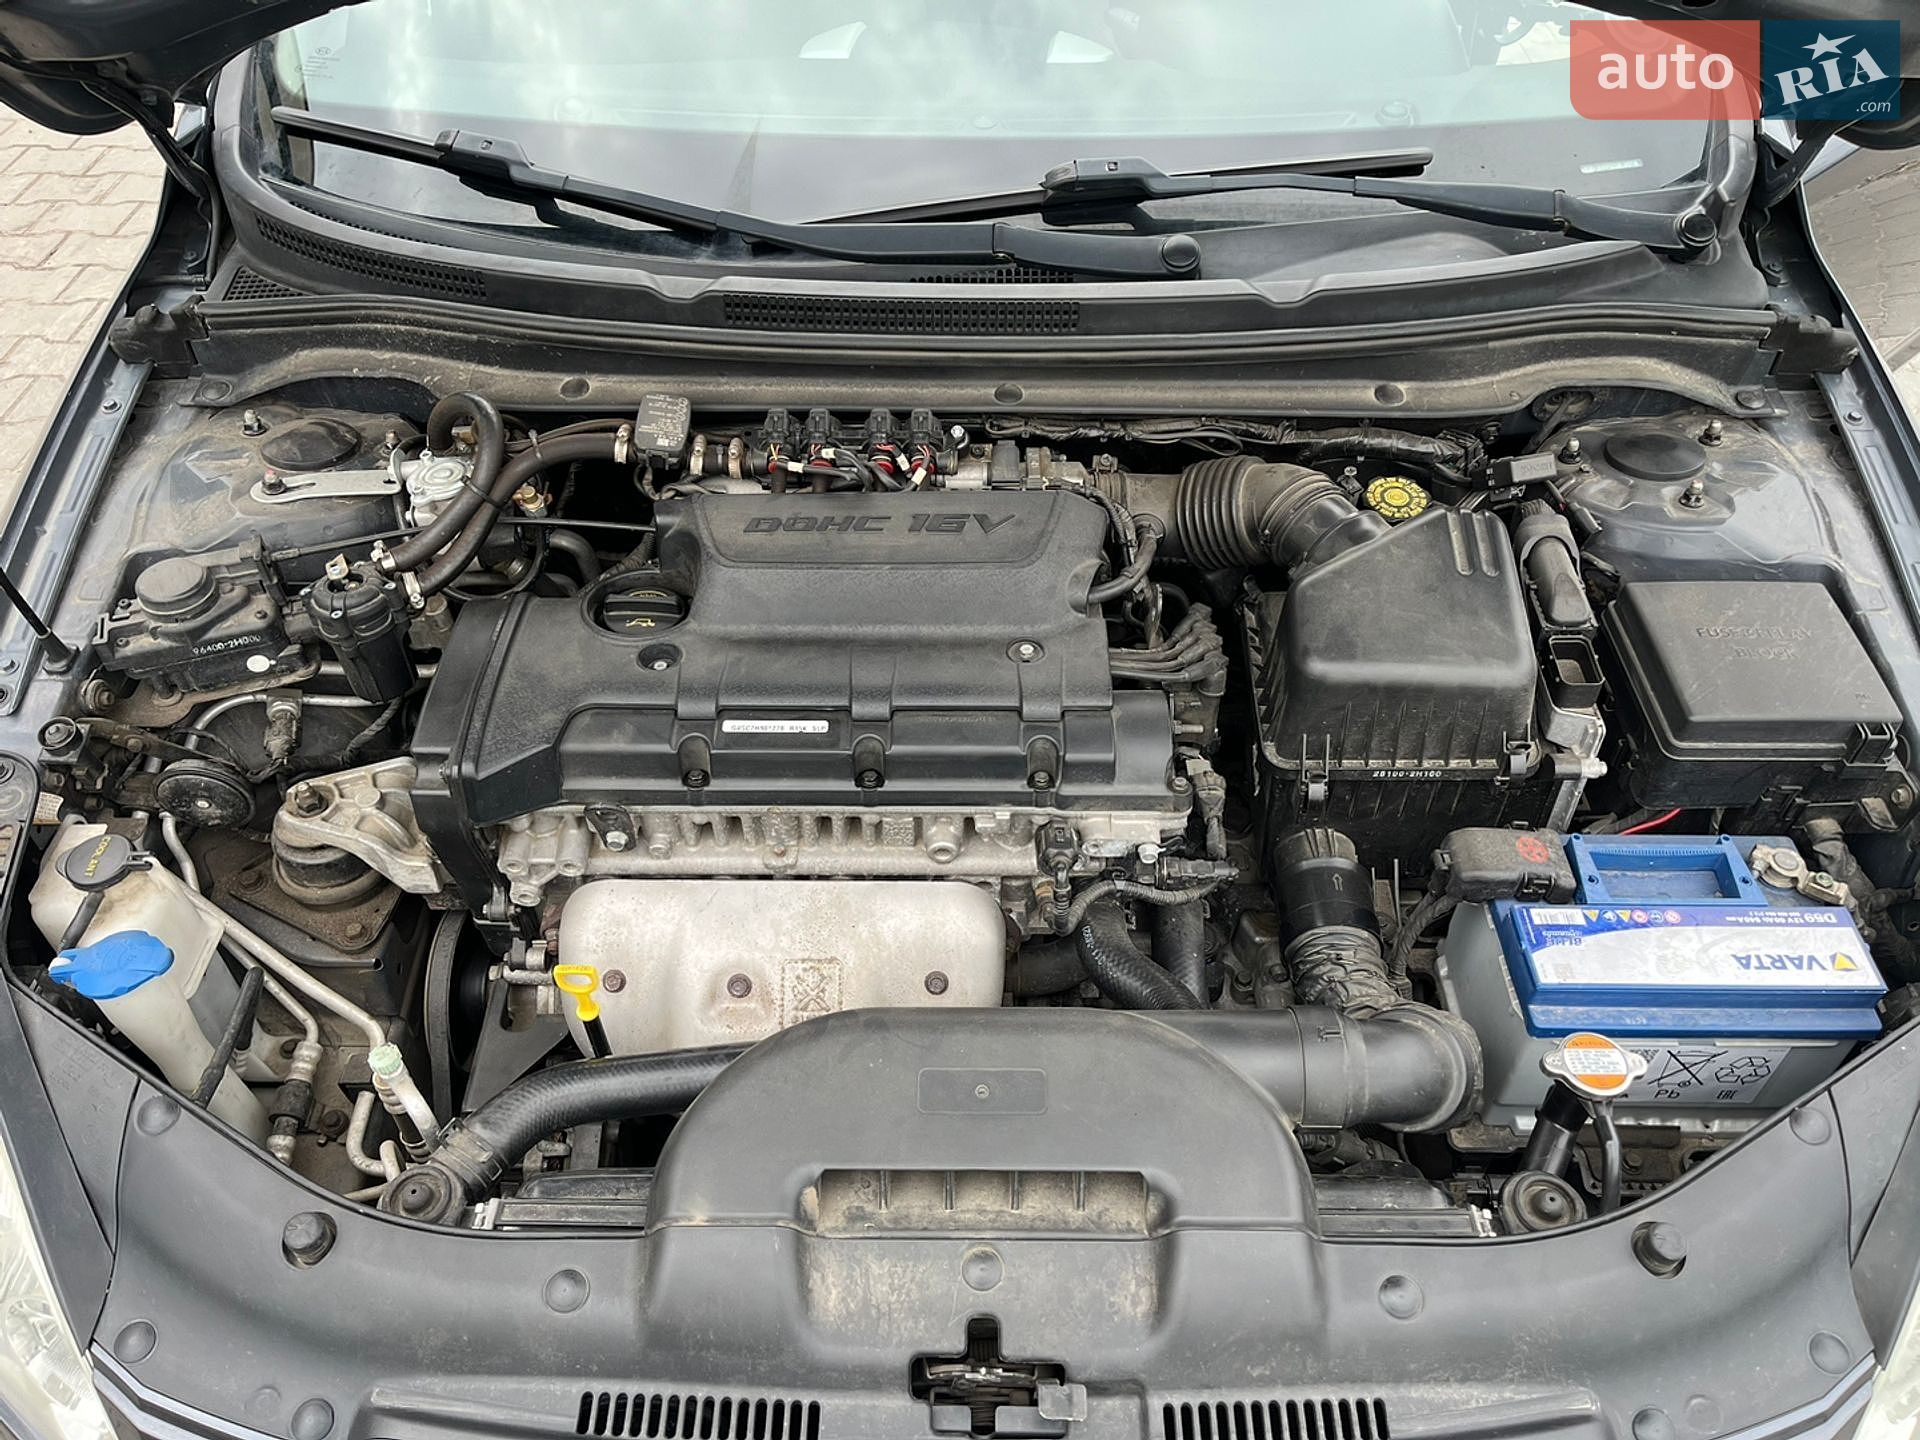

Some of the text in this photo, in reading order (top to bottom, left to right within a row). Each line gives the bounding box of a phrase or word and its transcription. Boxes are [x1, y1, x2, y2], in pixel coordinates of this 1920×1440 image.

[743, 513, 1016, 535] DOHC 16V
[1804, 912, 1838, 923] D59
[1730, 953, 1829, 970] VARTA
[1654, 1088, 1681, 1099] Pb
